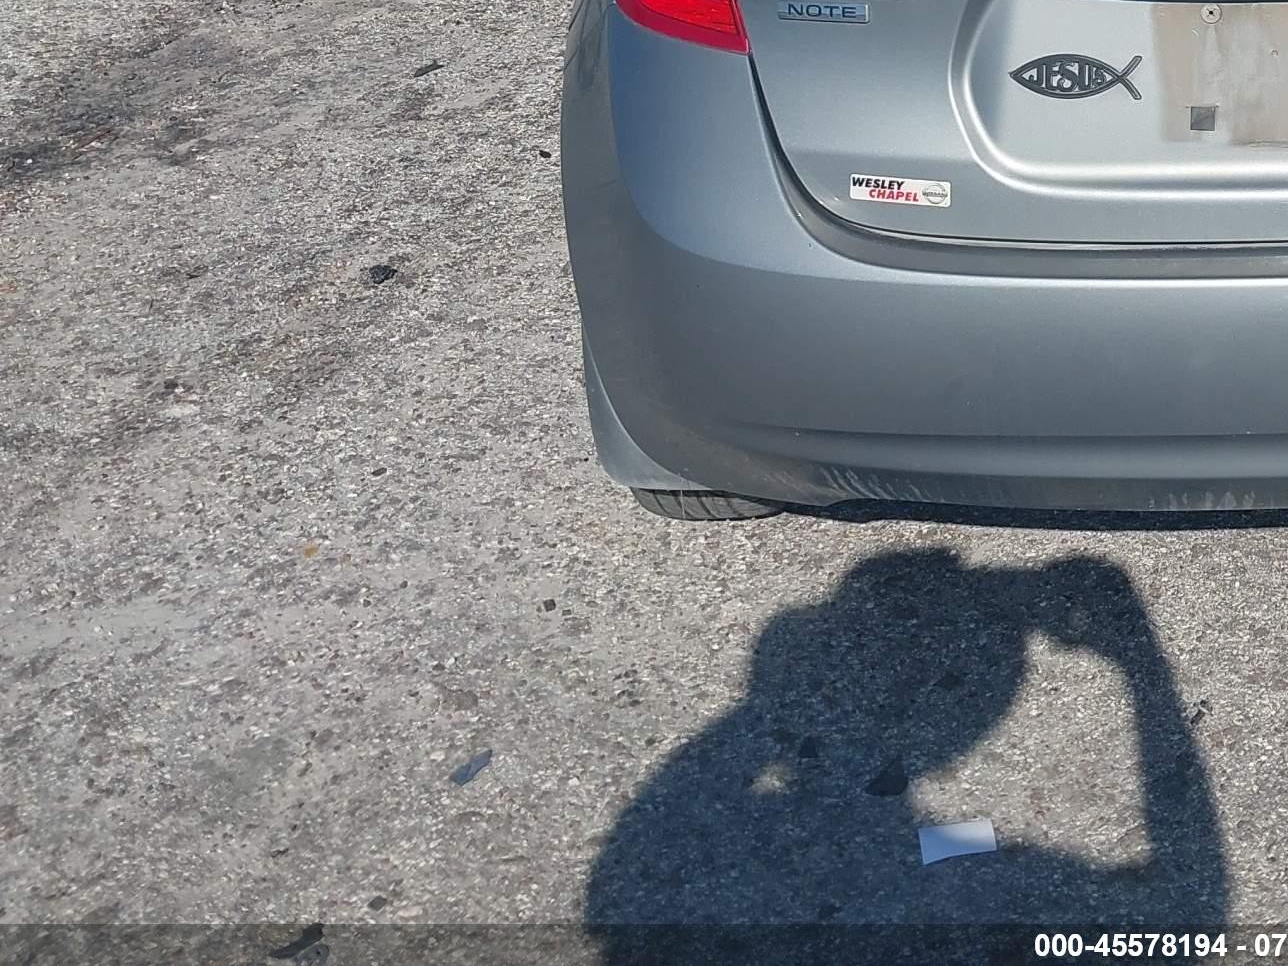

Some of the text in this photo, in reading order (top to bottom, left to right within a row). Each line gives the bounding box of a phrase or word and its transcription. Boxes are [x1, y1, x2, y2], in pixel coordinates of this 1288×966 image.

[787, 3, 857, 19] NOTE
[1021, 61, 1106, 92] JESUS
[852, 177, 905, 190] WESLEY
[869, 189, 919, 202] CHAPEL
